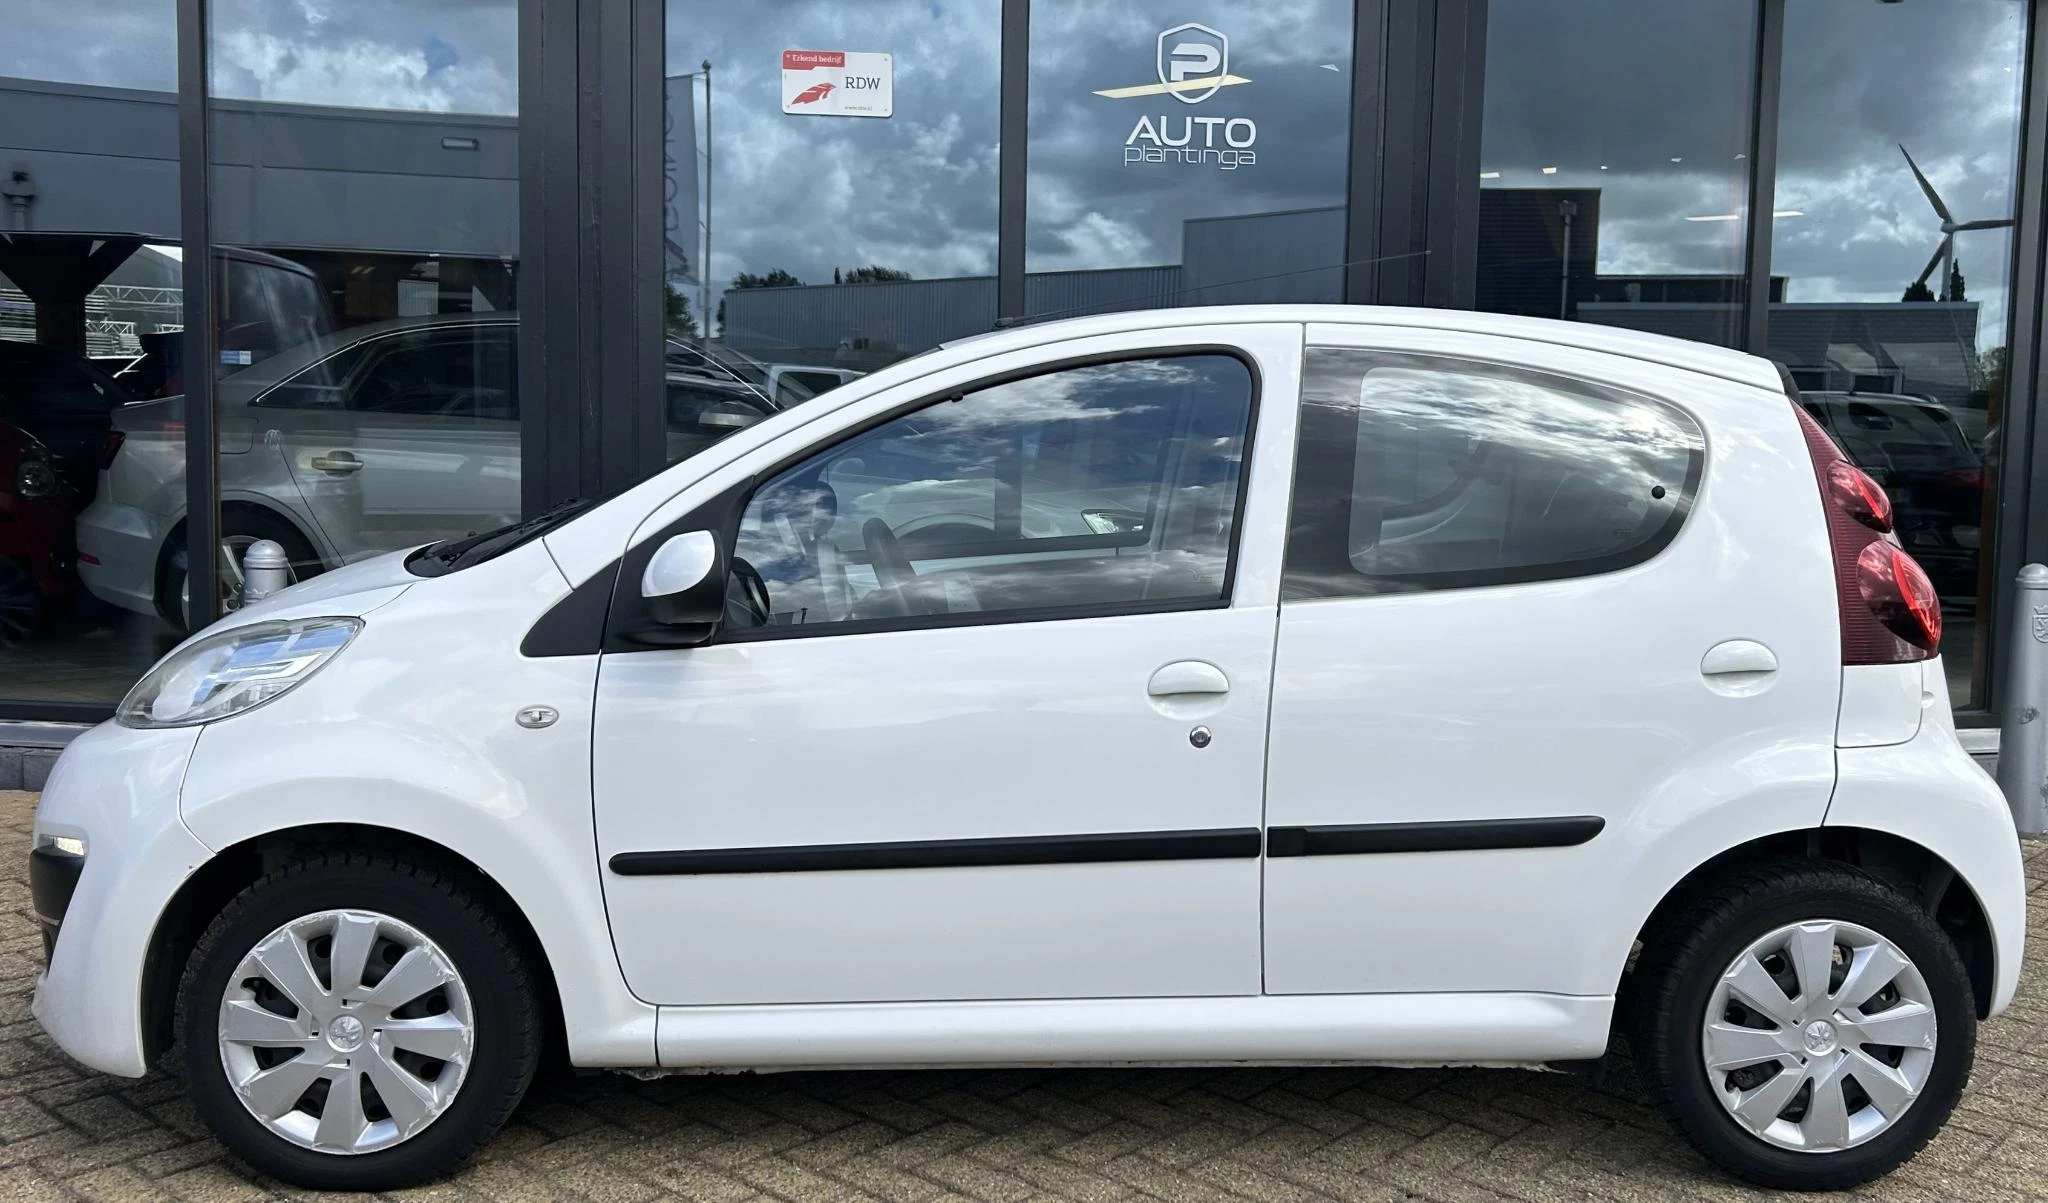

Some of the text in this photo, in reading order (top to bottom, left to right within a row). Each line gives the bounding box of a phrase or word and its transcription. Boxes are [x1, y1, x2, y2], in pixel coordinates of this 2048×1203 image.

[792, 54, 842, 64] Erkend bedrijf
[845, 76, 880, 90] RDW
[1125, 115, 1257, 148] AUTO
[1124, 144, 1256, 170] plantinga
